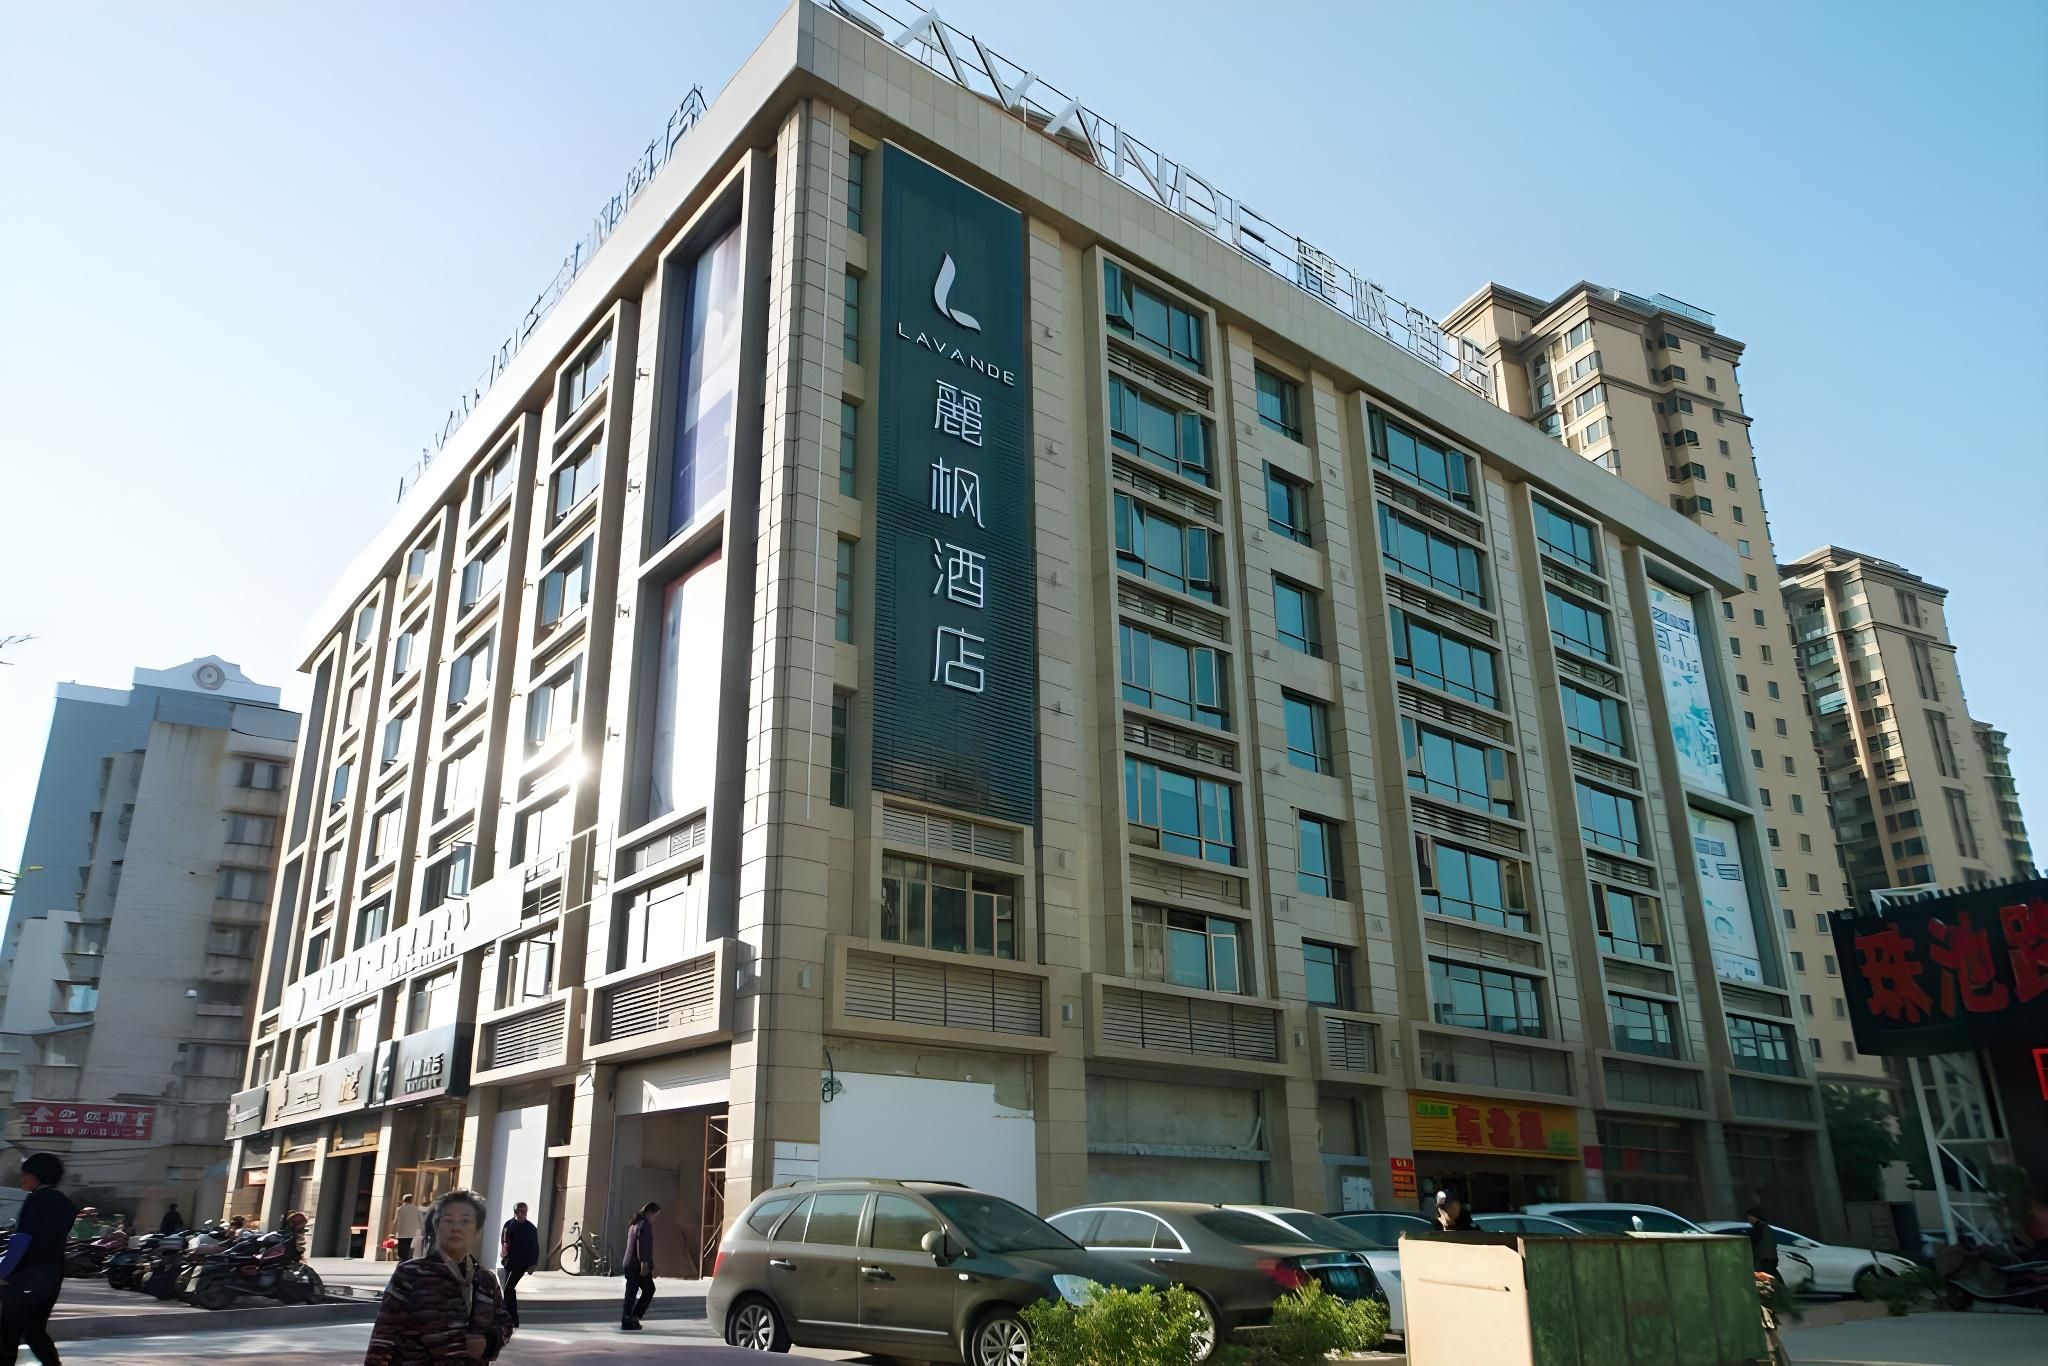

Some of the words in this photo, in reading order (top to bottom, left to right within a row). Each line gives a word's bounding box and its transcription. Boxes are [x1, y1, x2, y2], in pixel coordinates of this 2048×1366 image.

[897, 321, 1015, 387] LAVANDE
[930, 379, 986, 694] 麗枫酒店
